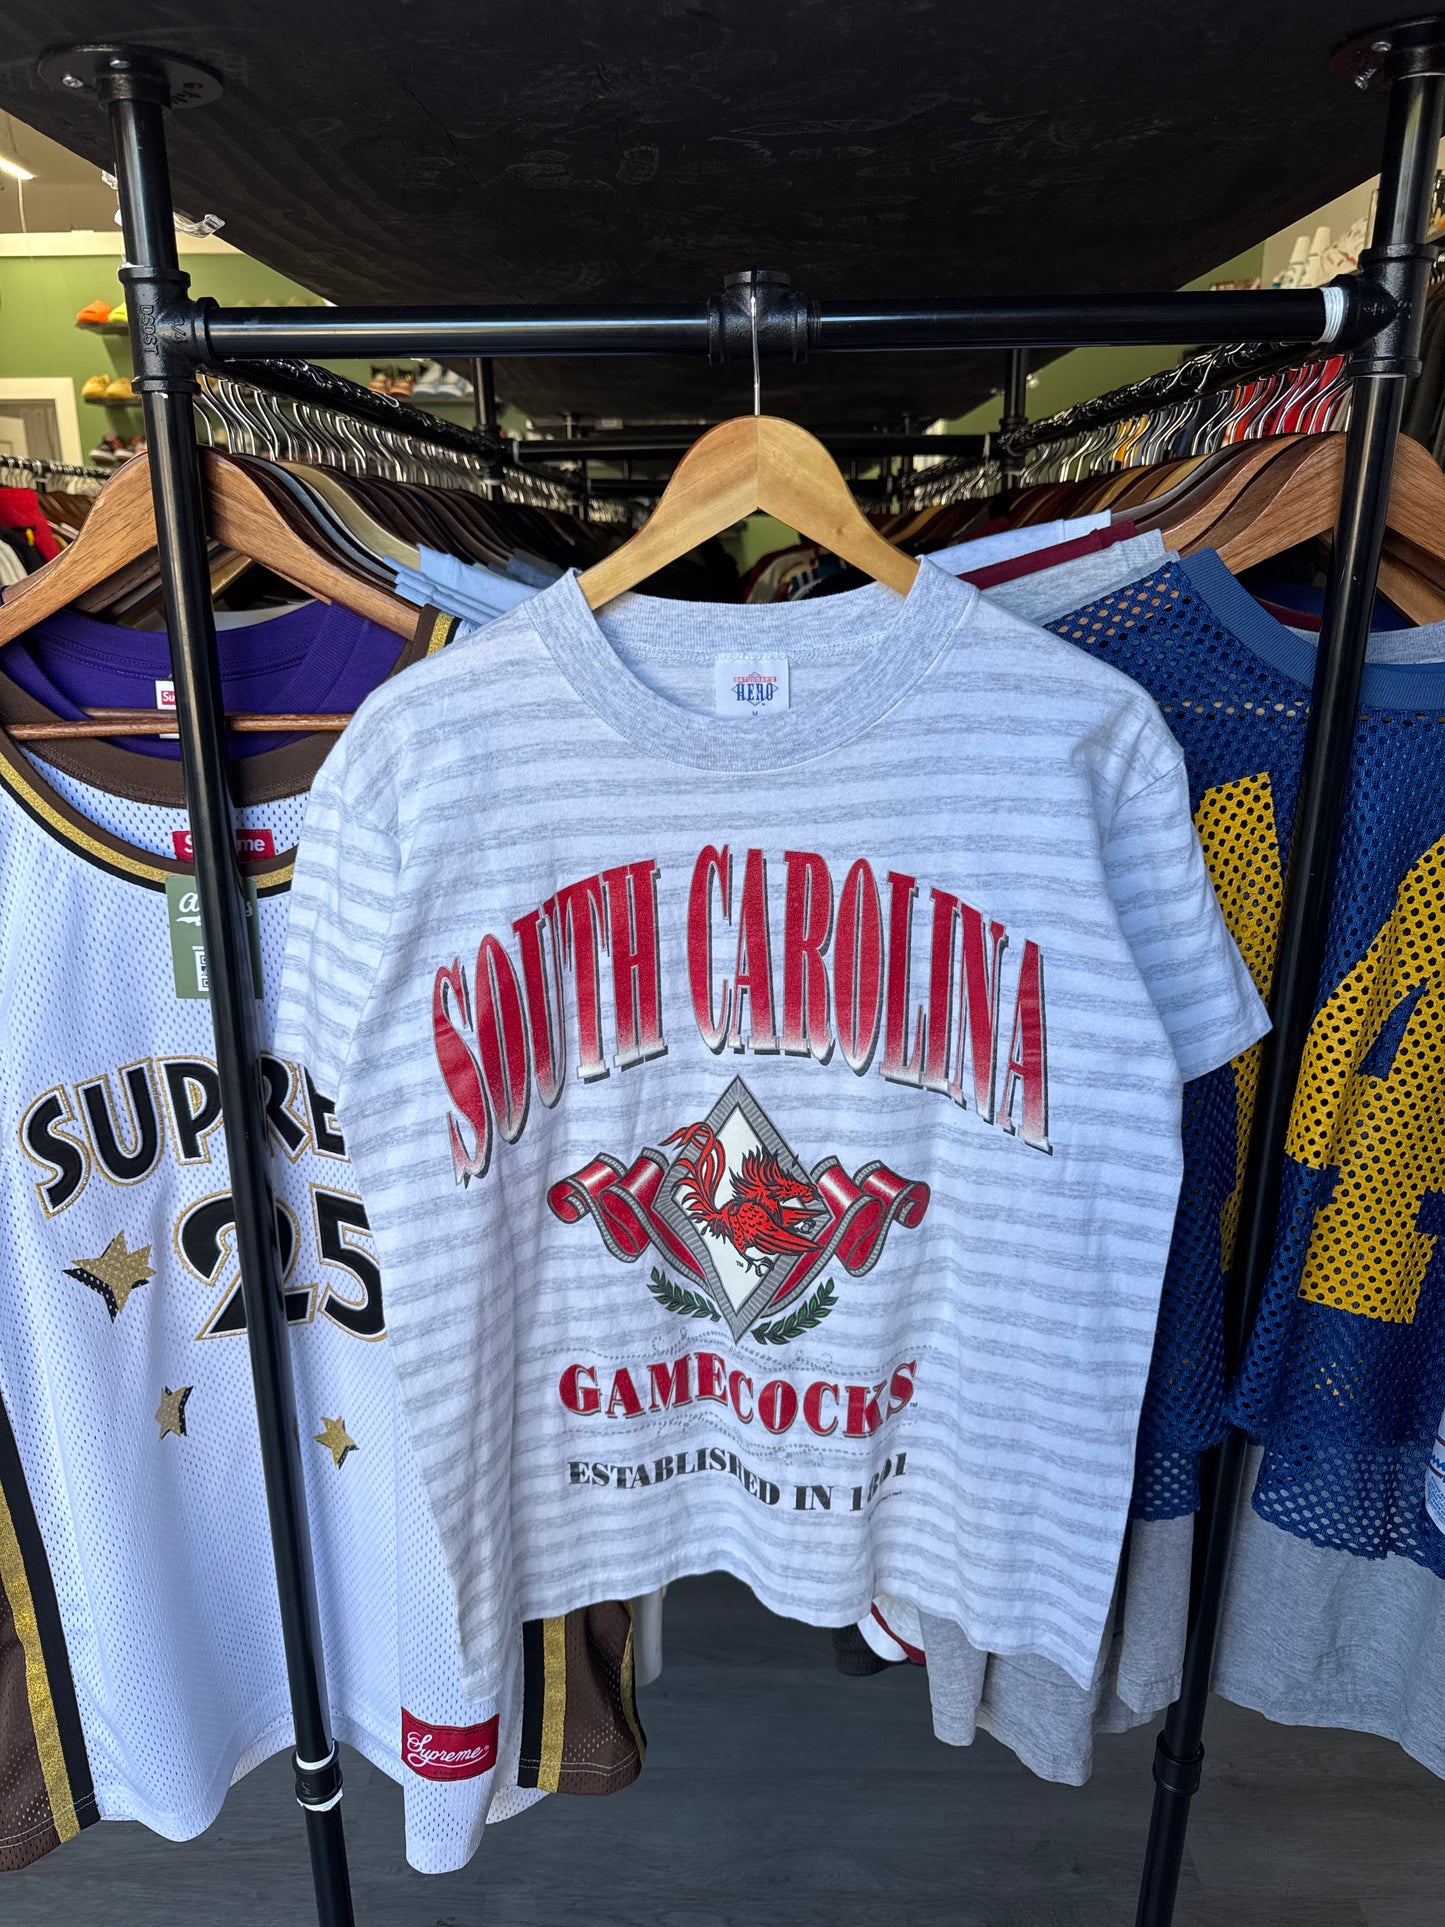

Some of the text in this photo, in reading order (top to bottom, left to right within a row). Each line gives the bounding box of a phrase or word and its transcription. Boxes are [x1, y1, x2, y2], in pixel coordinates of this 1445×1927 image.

[736, 683, 774, 702] HERO
[432, 844, 1053, 1188] SOUTH CAROLINA
[174, 1183, 388, 1343] 25
[559, 1351, 917, 1439] GAMECOCKS
[567, 1447, 781, 1505] ESTABLISHED
[793, 1484, 833, 1511] IN
[406, 1731, 490, 1768] Supreme
